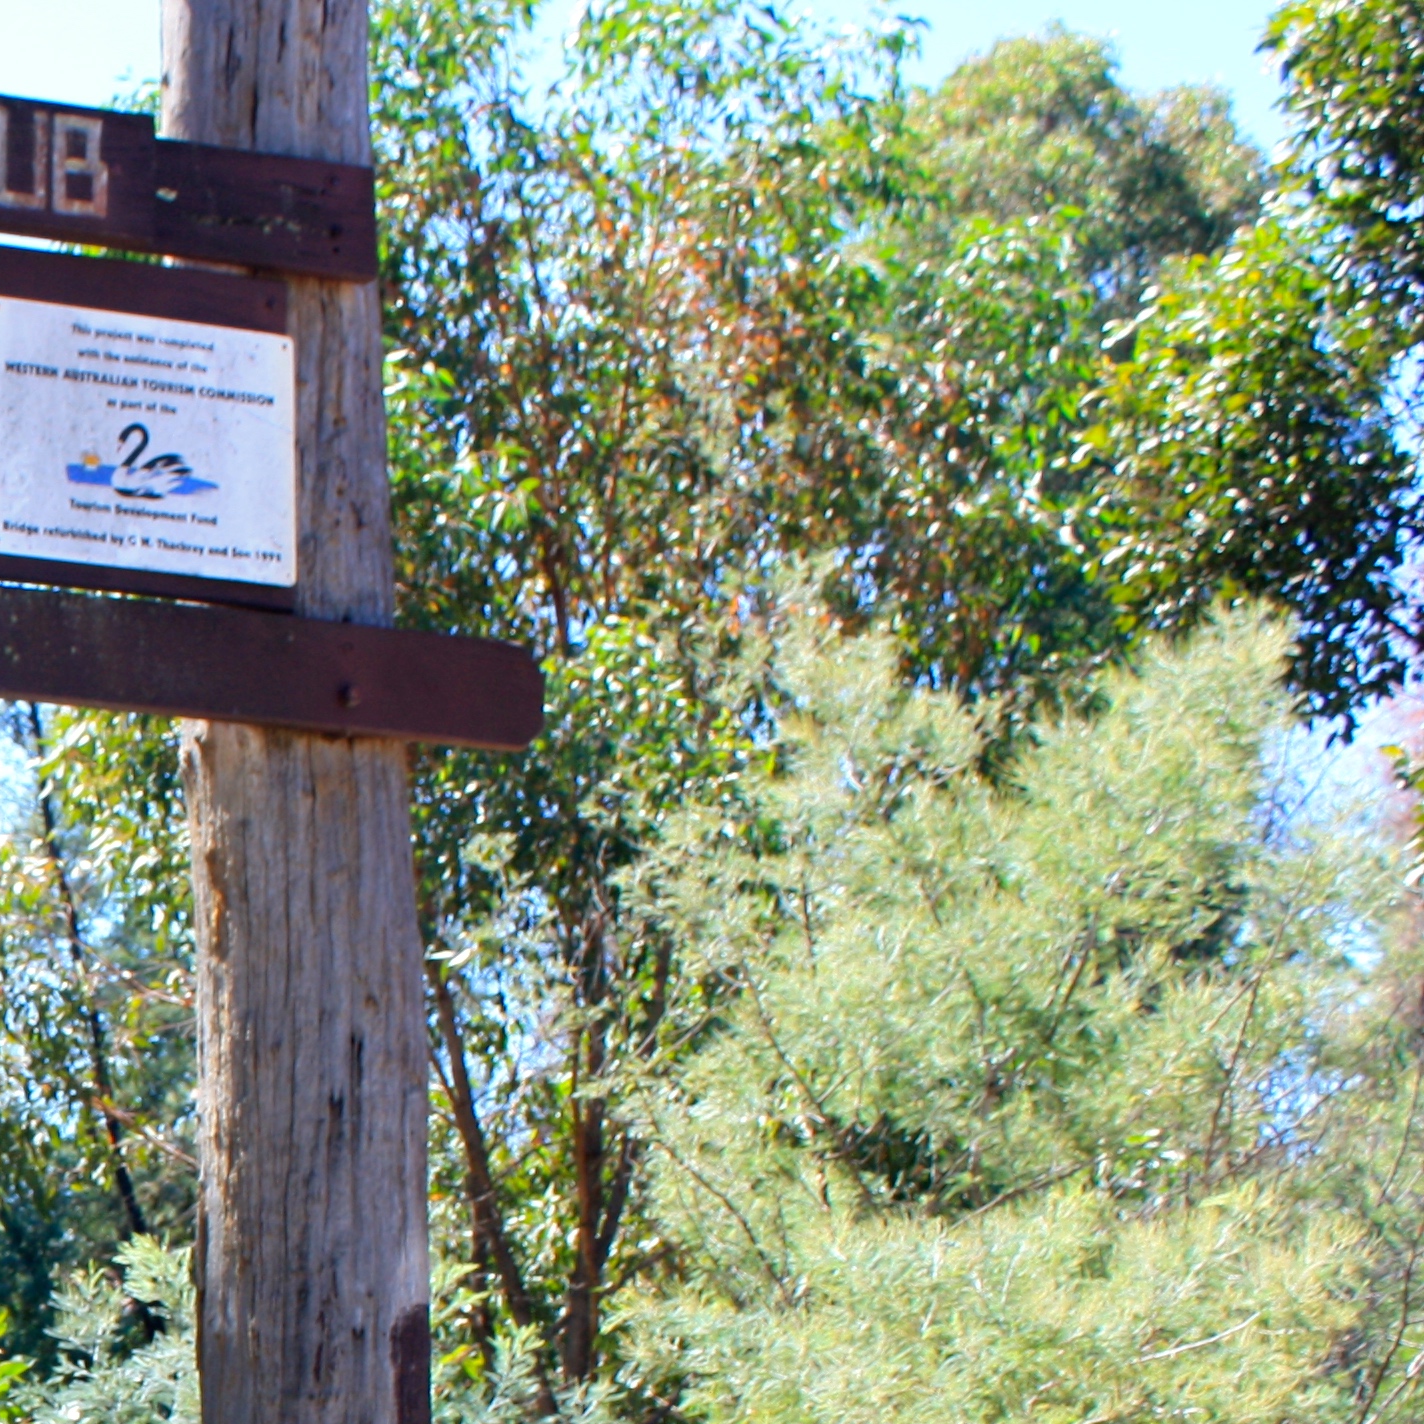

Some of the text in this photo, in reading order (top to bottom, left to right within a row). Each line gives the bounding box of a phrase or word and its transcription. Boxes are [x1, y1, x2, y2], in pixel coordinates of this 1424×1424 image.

[4, 359, 275, 407] WESTERN AUSTRALIAN TOURISM COMMISSION
[69, 498, 218, 527] Tourism Development Fund
[2, 519, 40, 536] Bridge
